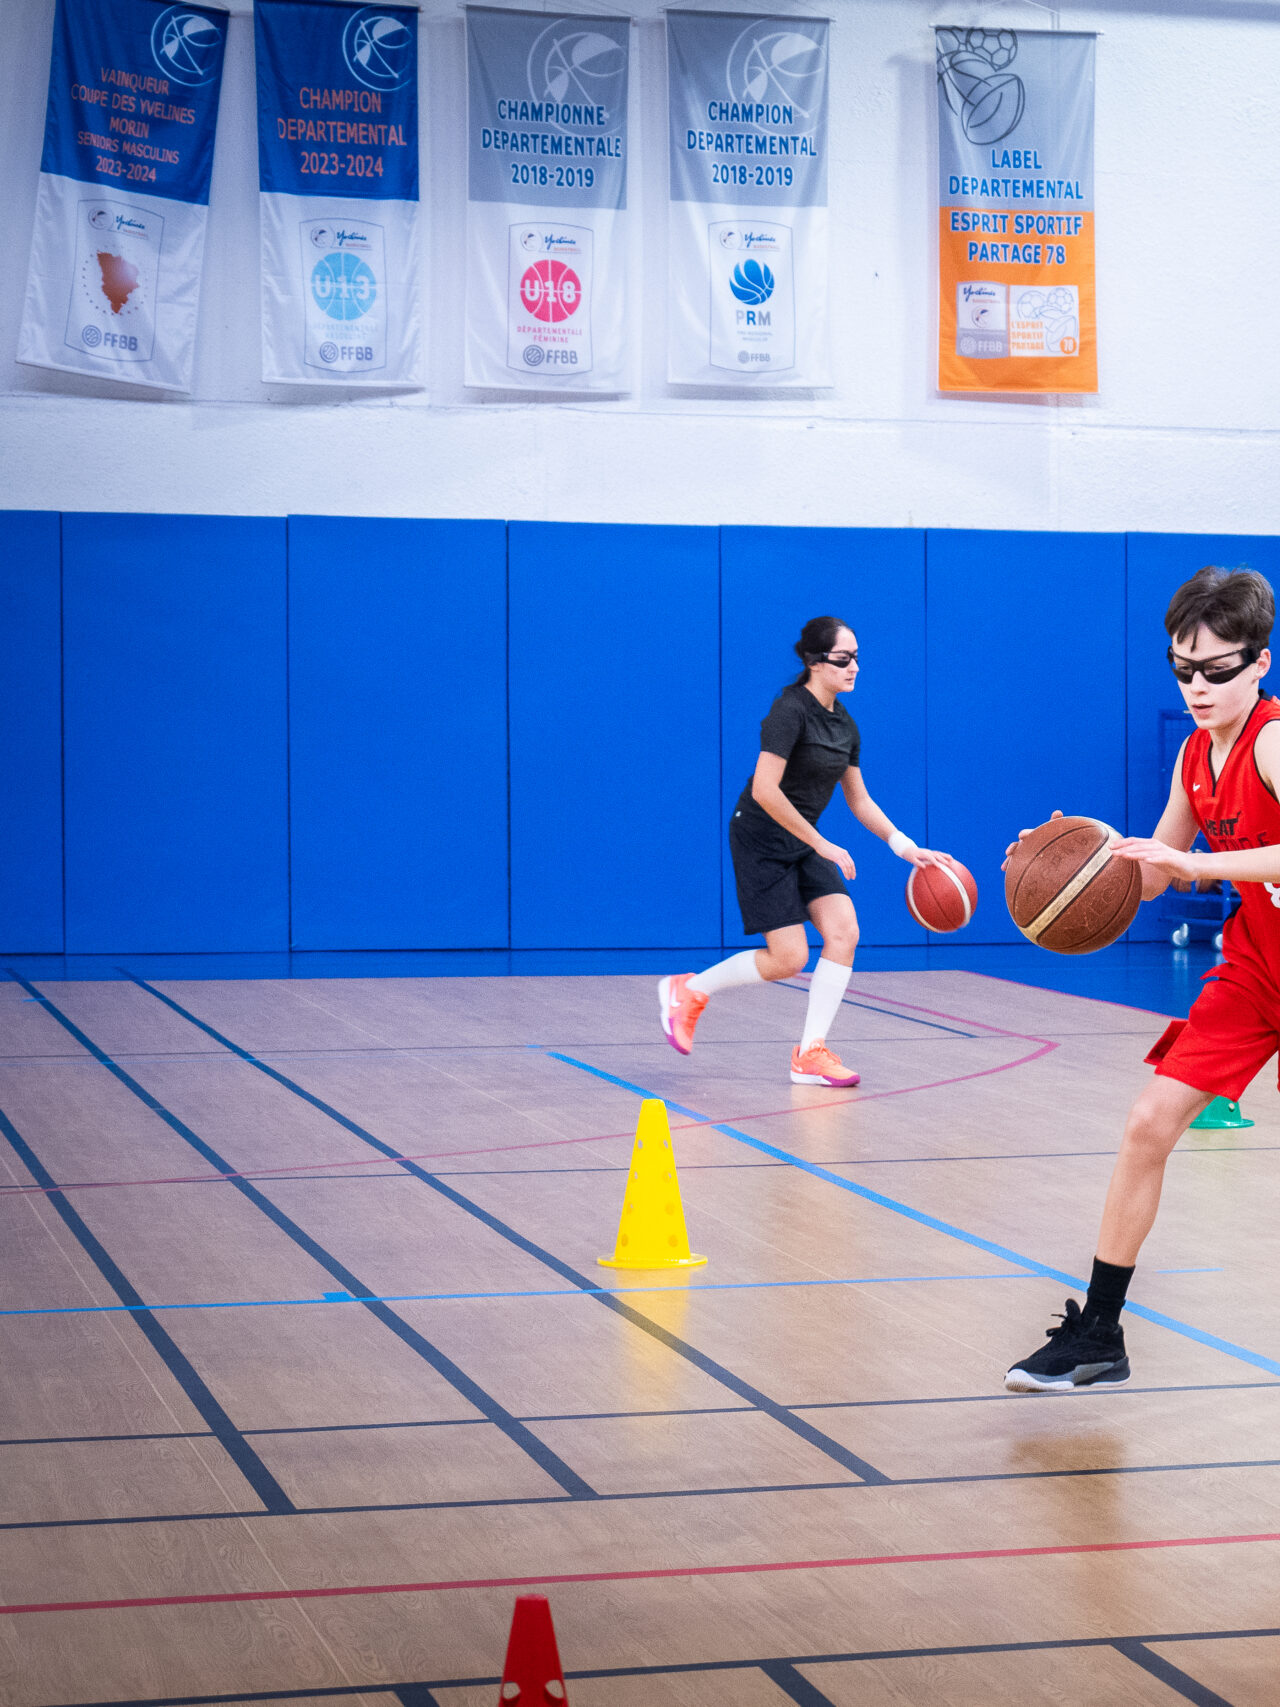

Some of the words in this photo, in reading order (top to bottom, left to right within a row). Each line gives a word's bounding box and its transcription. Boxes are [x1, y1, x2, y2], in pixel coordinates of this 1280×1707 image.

[101, 67, 169, 96] VAINQUEUR
[71, 84, 108, 107] COUPE
[111, 93, 136, 112] DES
[140, 99, 195, 124] YVELINES
[300, 87, 382, 113] CHAMPION
[497, 99, 606, 126] CHAMPIONNE
[708, 101, 793, 124] CHAMPION
[110, 117, 149, 138] MORIN
[277, 118, 407, 146] DEPARTEMENTAL
[78, 131, 119, 152] SENIORS
[123, 141, 179, 164] MASCULINS
[481, 128, 622, 158] DEPARTEMENTALE
[687, 129, 817, 156] DEPARTEMENTAL
[96, 155, 156, 182] 2023-2024
[301, 151, 383, 177] 2023-2024
[991, 149, 1042, 169] LABEL
[511, 163, 594, 188] 2018-2019
[712, 164, 793, 186] 2018-2019
[949, 175, 1083, 199] DEPARTEMENTAL
[951, 211, 1009, 233] ESPRIT
[1014, 214, 1082, 235] SPORTIF
[968, 241, 1041, 264] PARTAGE
[1046, 245, 1066, 264] 78
[315, 275, 370, 299] U13
[524, 279, 576, 303] U18
[735, 310, 771, 326] PRM
[104, 332, 138, 351] FFBB
[341, 346, 373, 361] FFBB
[546, 349, 578, 364] FFBB
[1204, 811, 1242, 836] HEAT
